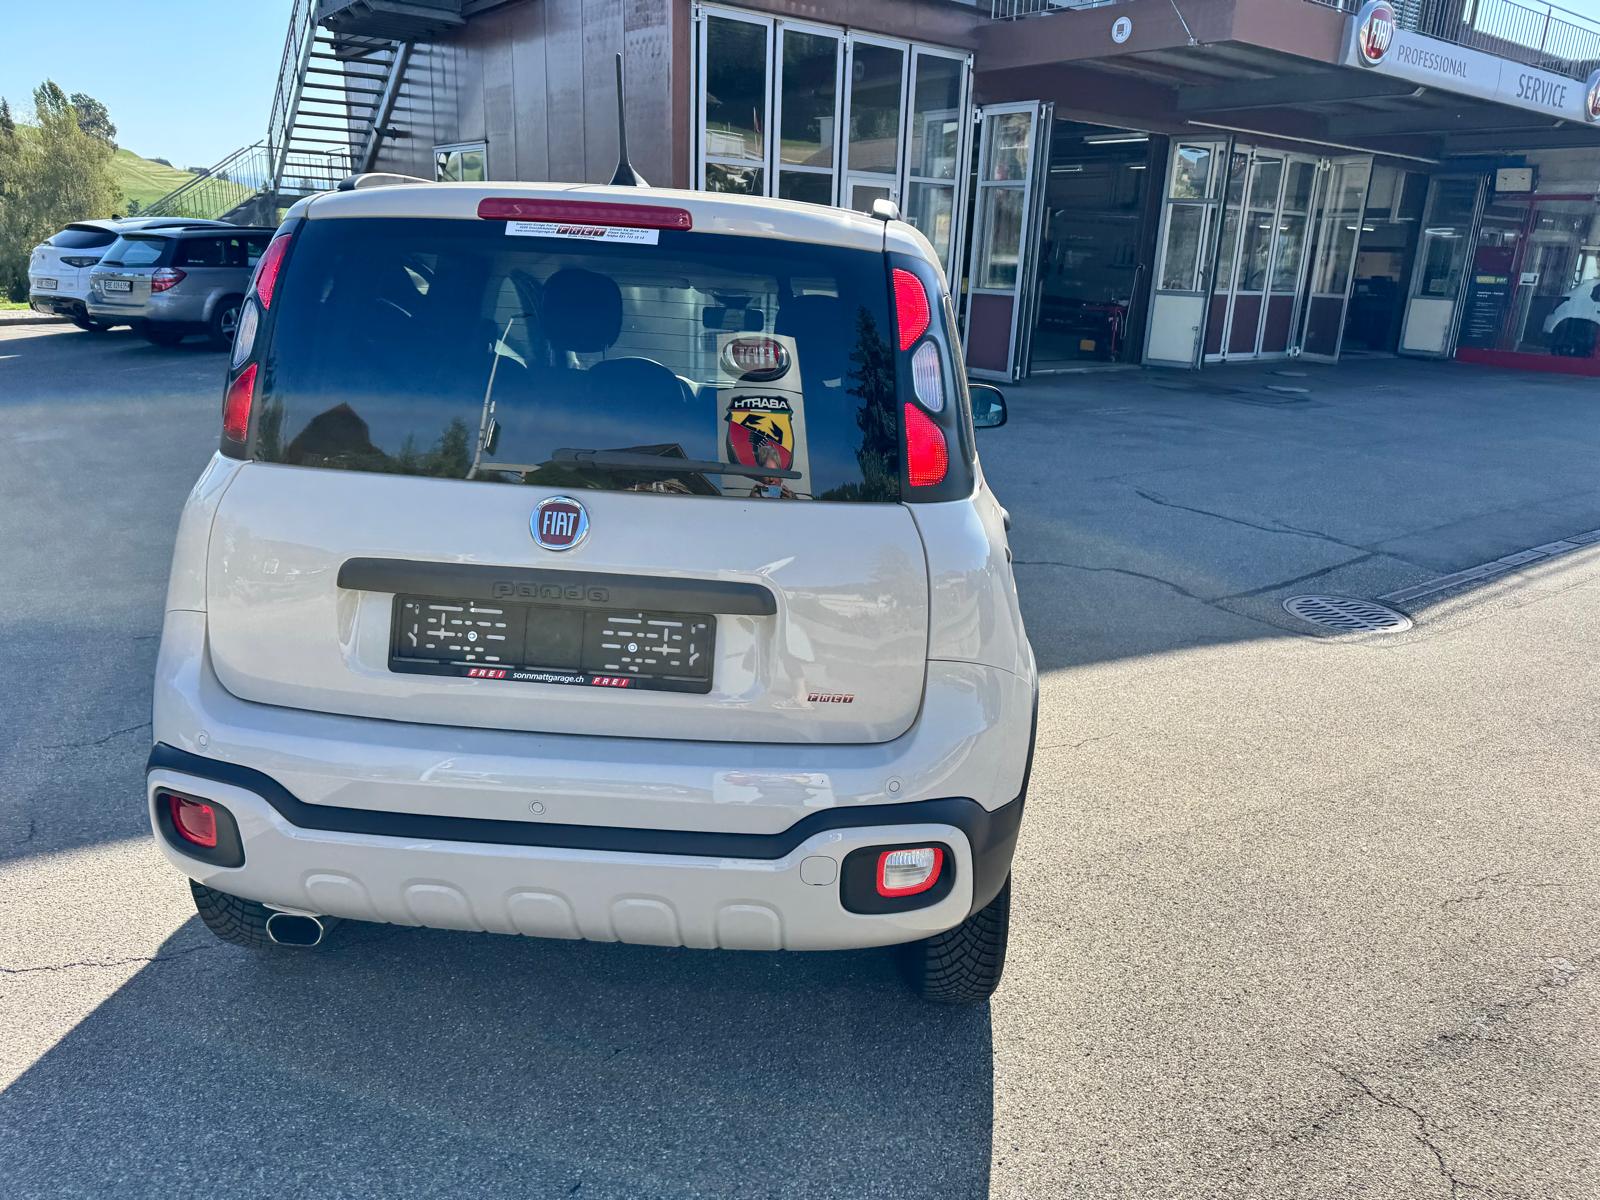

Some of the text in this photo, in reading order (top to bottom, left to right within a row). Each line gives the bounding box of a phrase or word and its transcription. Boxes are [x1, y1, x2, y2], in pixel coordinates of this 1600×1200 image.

[1369, 18, 1391, 50] FIAT
[1398, 44, 1467, 78] PROFESSIONAL
[1516, 73, 1567, 108] SERVICE
[542, 511, 577, 536] FIAT
[468, 668, 629, 687] FREI sonnmattgarage.ch FREI
